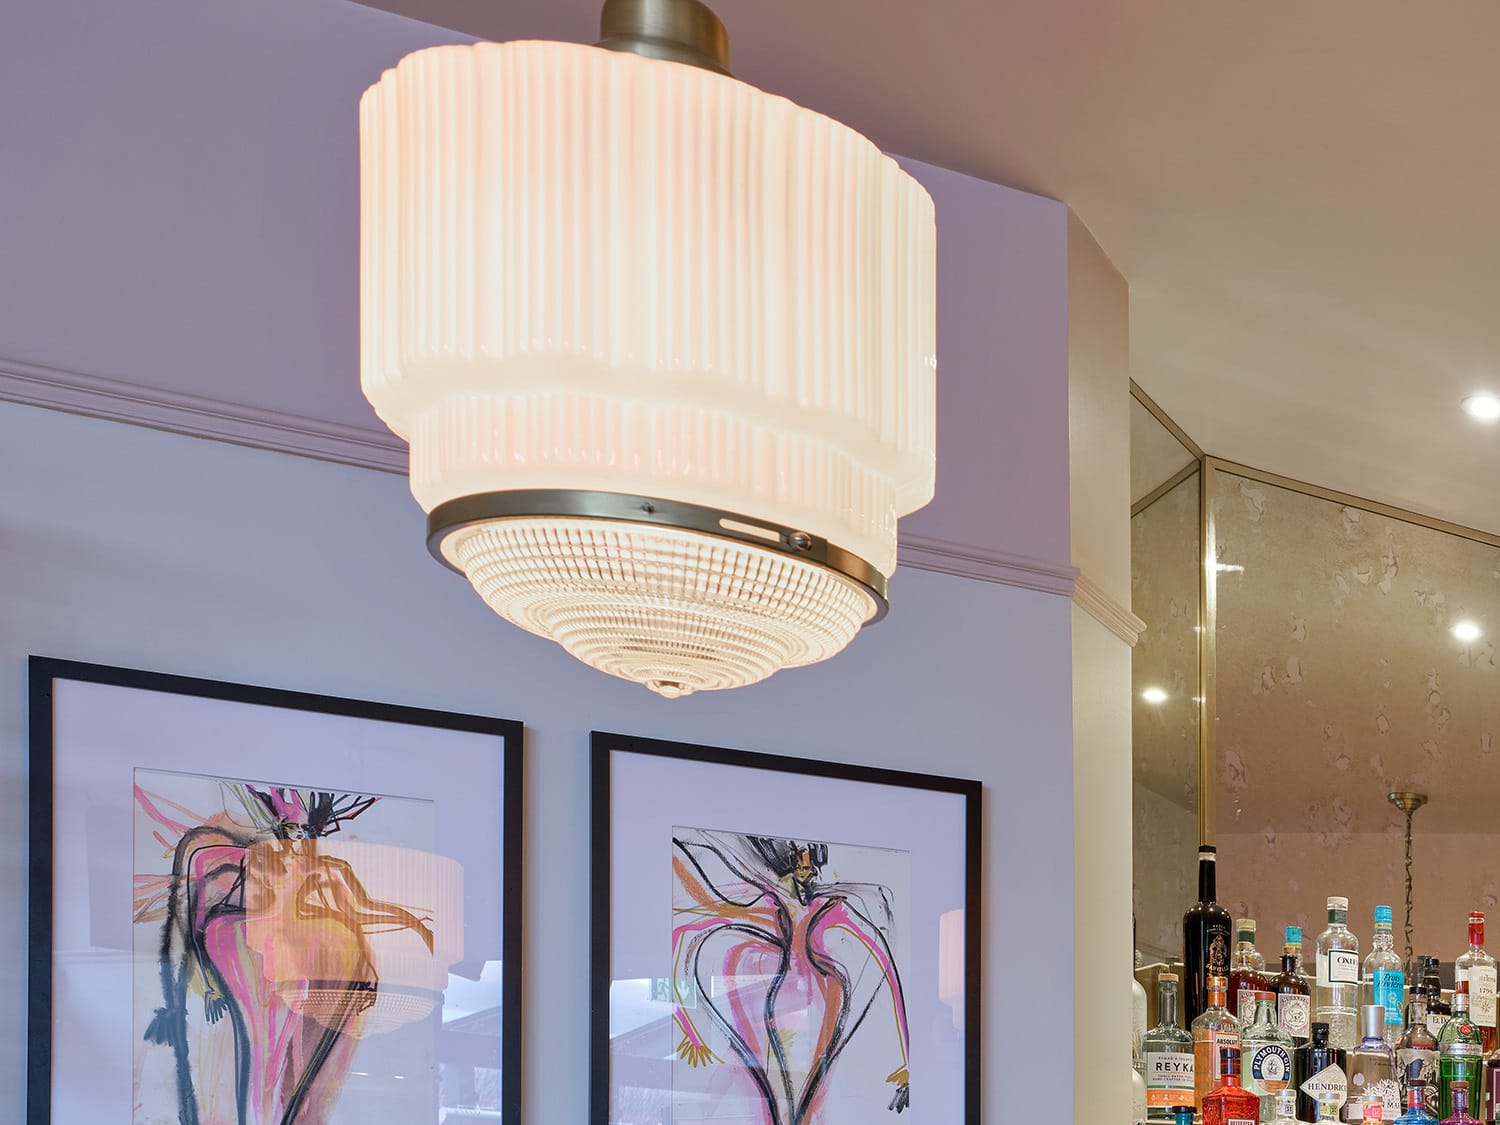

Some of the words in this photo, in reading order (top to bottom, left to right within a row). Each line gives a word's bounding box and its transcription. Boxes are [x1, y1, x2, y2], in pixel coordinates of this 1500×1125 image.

[1216, 1038, 1239, 1046] ABSOLUT
[1254, 1045, 1287, 1070] PLYMOUTH
[1156, 1062, 1194, 1073] REYKA
